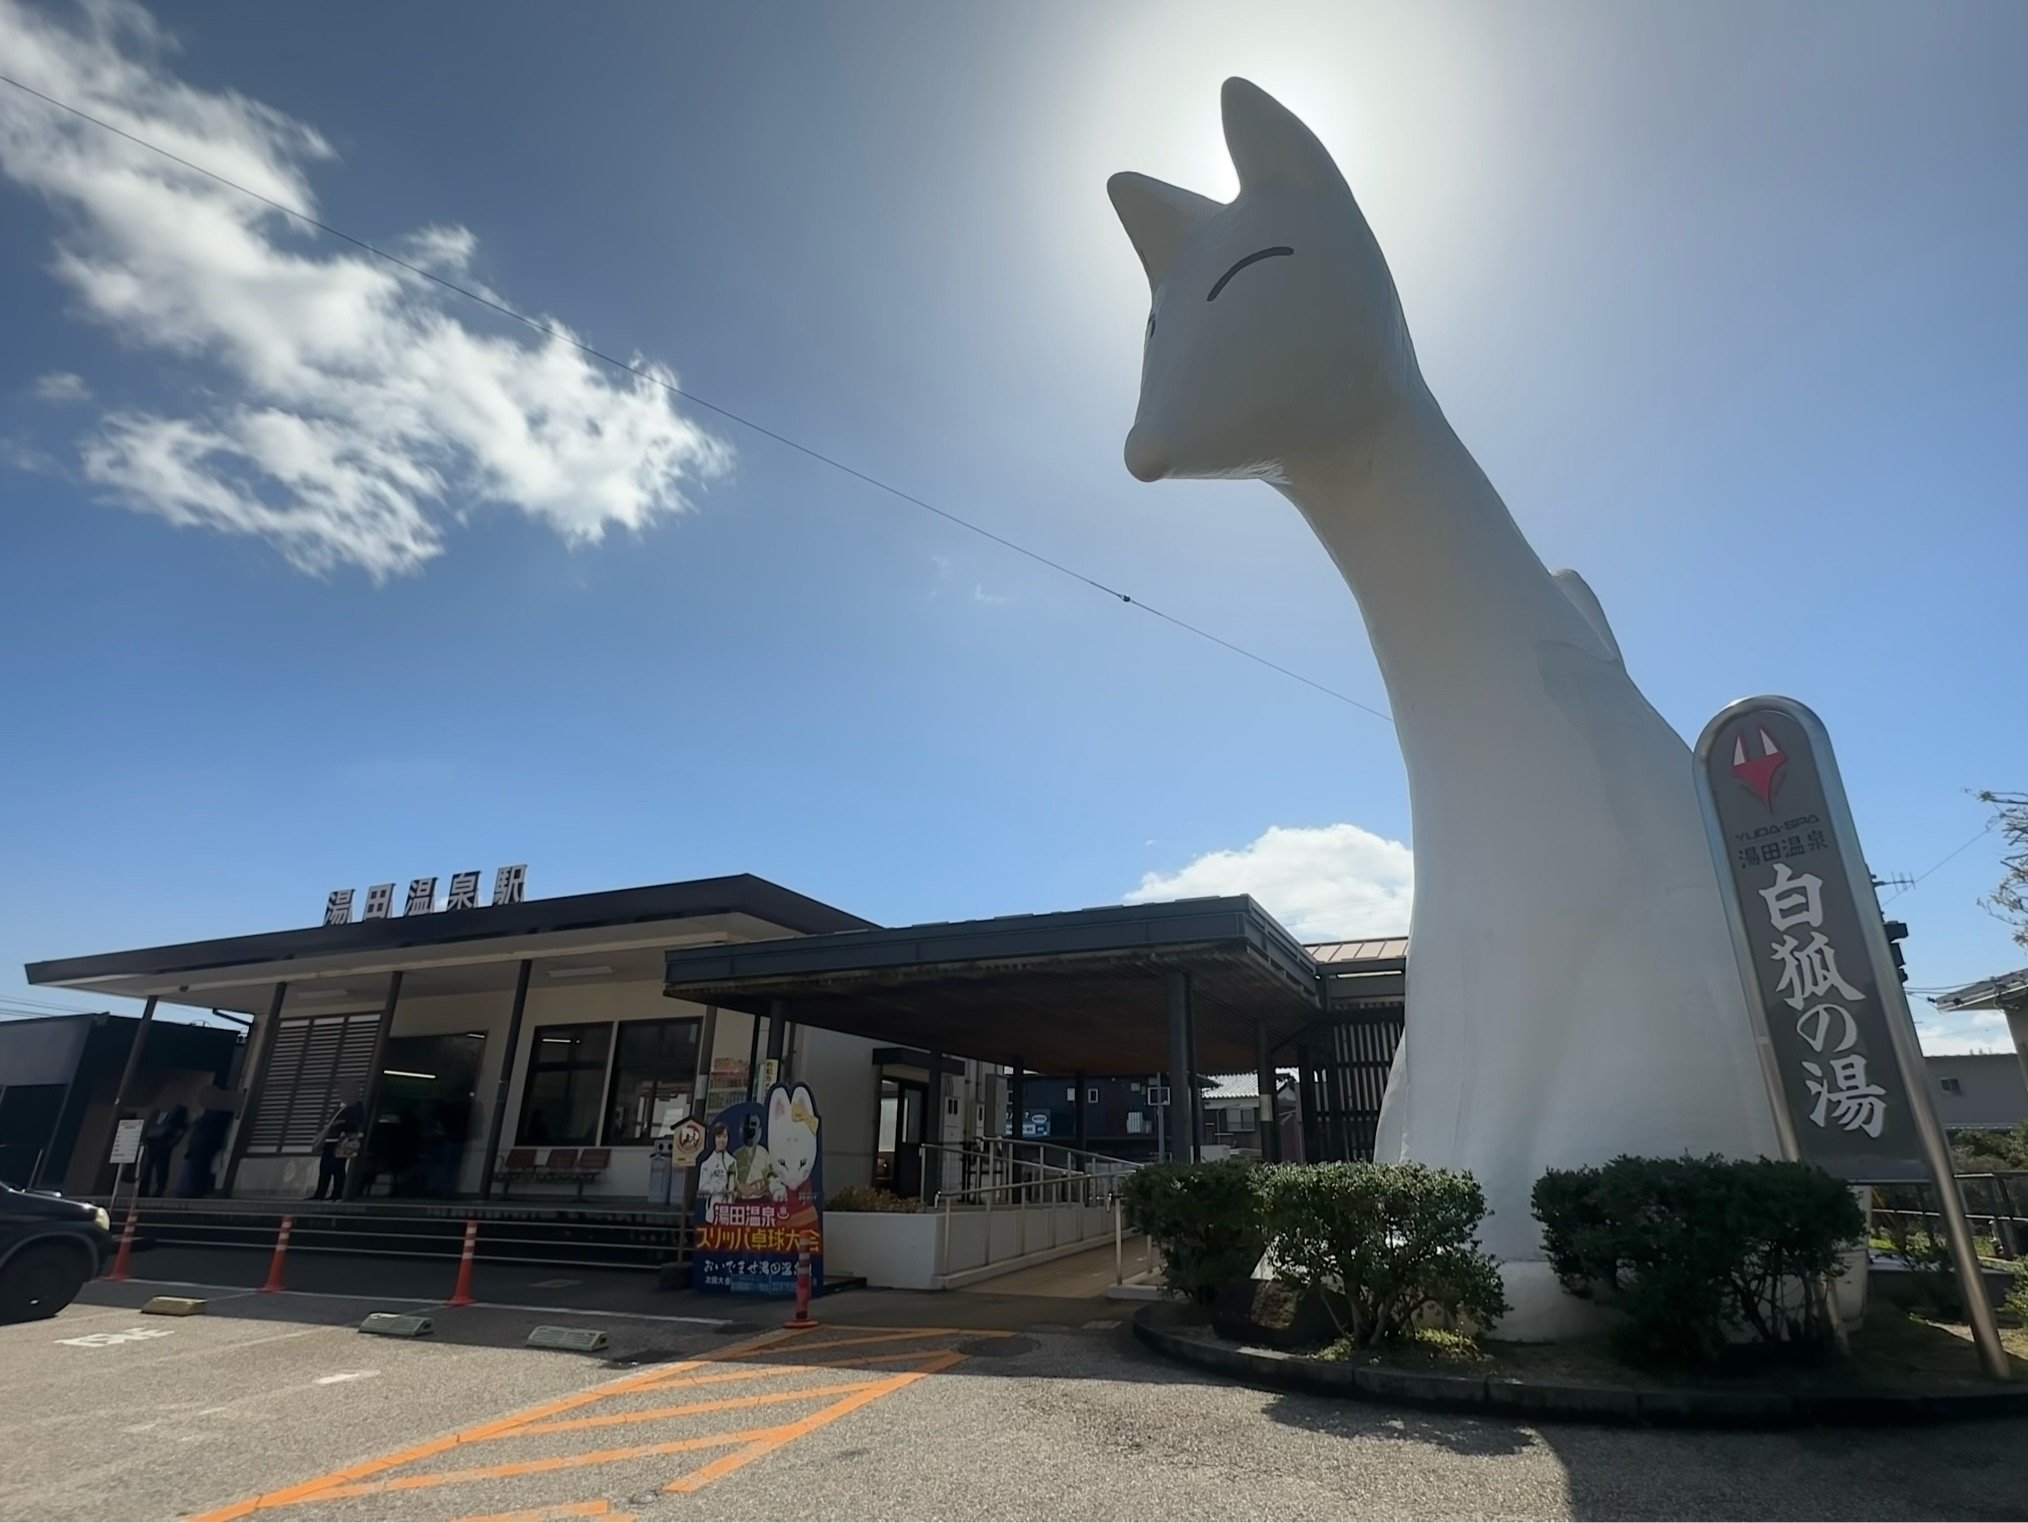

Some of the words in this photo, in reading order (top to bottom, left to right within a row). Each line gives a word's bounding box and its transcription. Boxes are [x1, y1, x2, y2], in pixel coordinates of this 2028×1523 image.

[1735, 813, 1821, 843] YUDA-SPA
[1738, 829, 1829, 869] 湯田温泉
[324, 864, 528, 925] 湯田温泉駅
[1758, 862, 1887, 1138] 白狐の湯
[713, 1204, 776, 1227] 湯田温泉
[696, 1226, 821, 1253] スリッパ卓球大会
